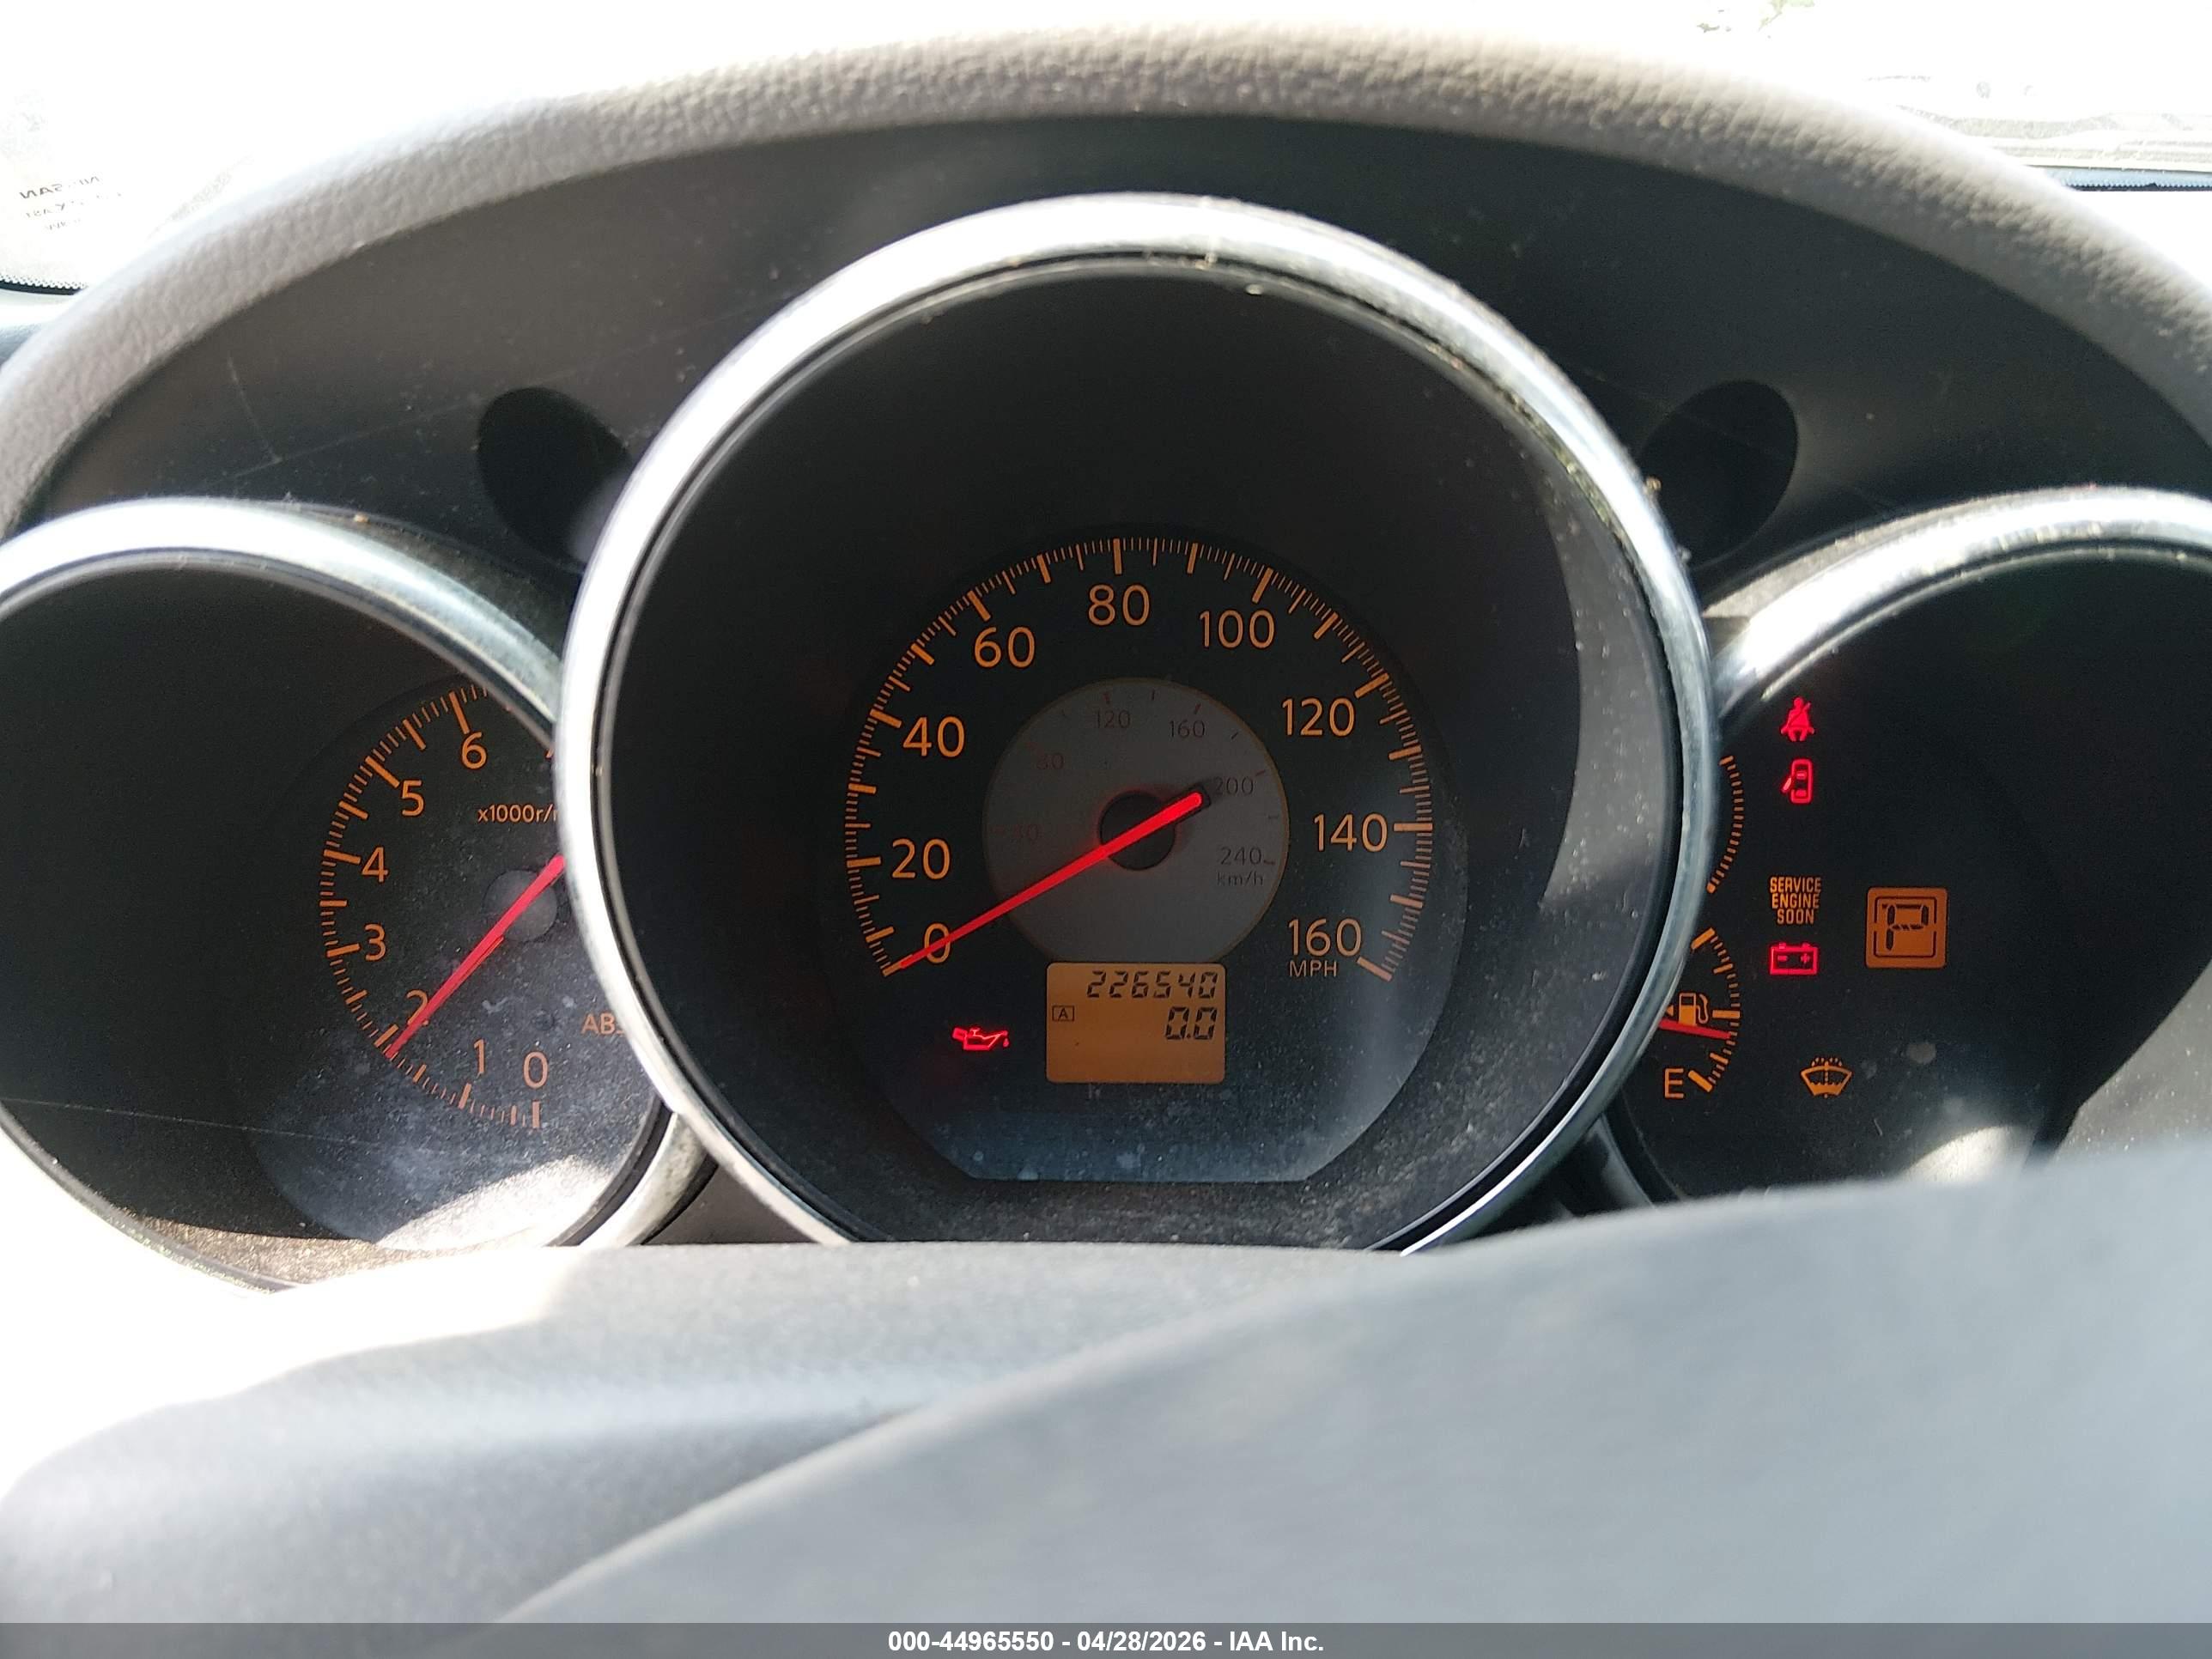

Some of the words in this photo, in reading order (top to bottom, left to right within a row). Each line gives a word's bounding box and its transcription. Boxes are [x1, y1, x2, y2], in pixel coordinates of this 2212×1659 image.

[1087, 584, 1151, 626] 80
[973, 626, 1036, 668] 60
[1199, 610, 1276, 648] 100
[902, 715, 966, 757] 40
[1095, 709, 1132, 730] 120
[1169, 720, 1206, 738] 160
[1281, 698, 1356, 737] 120
[461, 732, 488, 769] 6
[401, 779, 425, 817] 5
[1214, 776, 1255, 796] 200
[1313, 813, 1389, 852] 140
[361, 846, 389, 883] 4
[890, 838, 951, 880] 20
[1219, 847, 1262, 866] 240
[1216, 870, 1264, 887] km/h
[1770, 876, 1822, 894] SERVICE
[1771, 893, 1820, 910] ENGINE
[1776, 909, 1815, 925] SOON
[364, 924, 386, 962] 3
[924, 922, 951, 964] 0
[1288, 919, 1363, 957] 160
[1881, 903, 1930, 951] P
[1086, 970, 1218, 999] 226540
[1289, 959, 1339, 978] MPH
[580, 1012, 626, 1036] AB
[1164, 1006, 1218, 1041] 0.0
[474, 1039, 485, 1074] 1
[523, 1050, 550, 1089] 0
[1664, 1067, 1685, 1099] E
